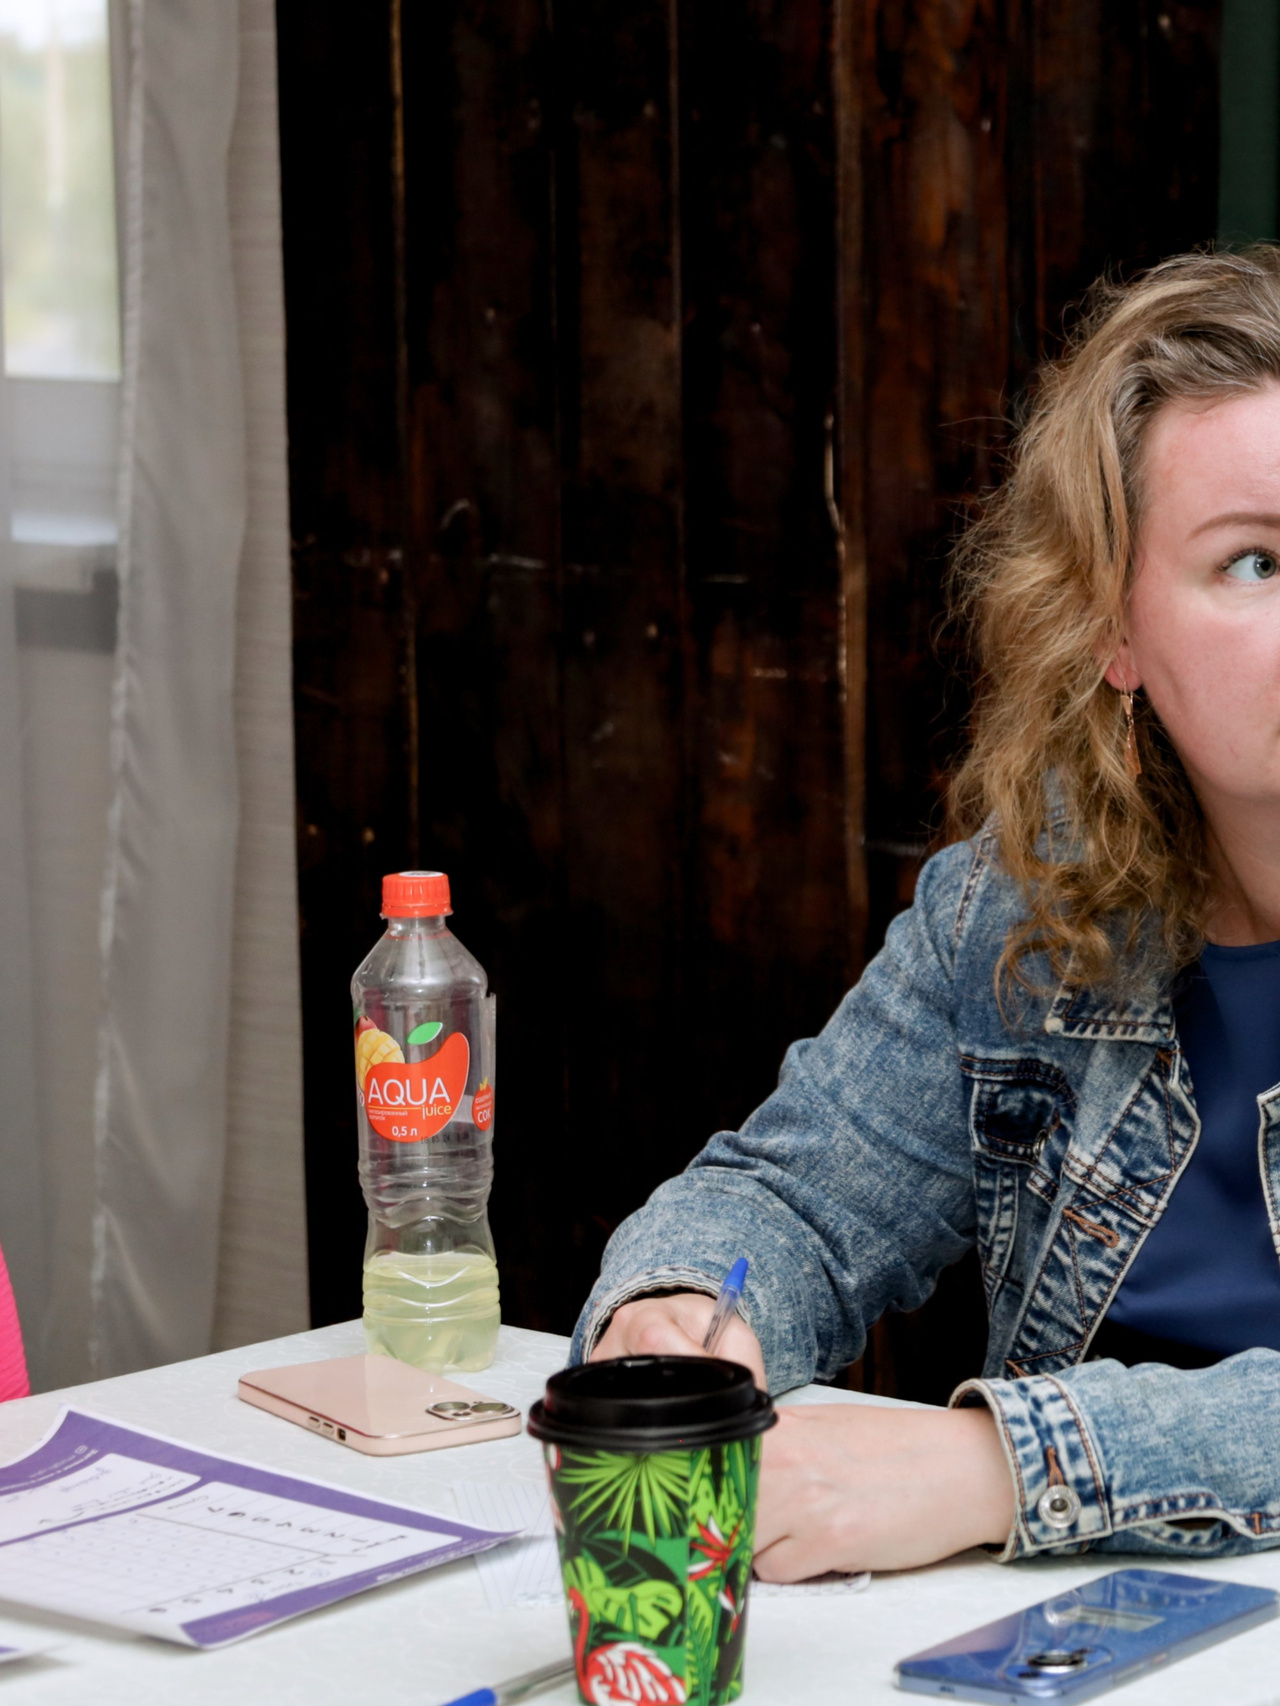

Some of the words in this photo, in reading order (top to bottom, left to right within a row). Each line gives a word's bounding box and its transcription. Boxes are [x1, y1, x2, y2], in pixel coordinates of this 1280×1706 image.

[368, 1077, 451, 1106] AQUA
[422, 1104, 452, 1120] juice
[392, 1126, 408, 1137] 0,5
[410, 1126, 418, 1136] л
